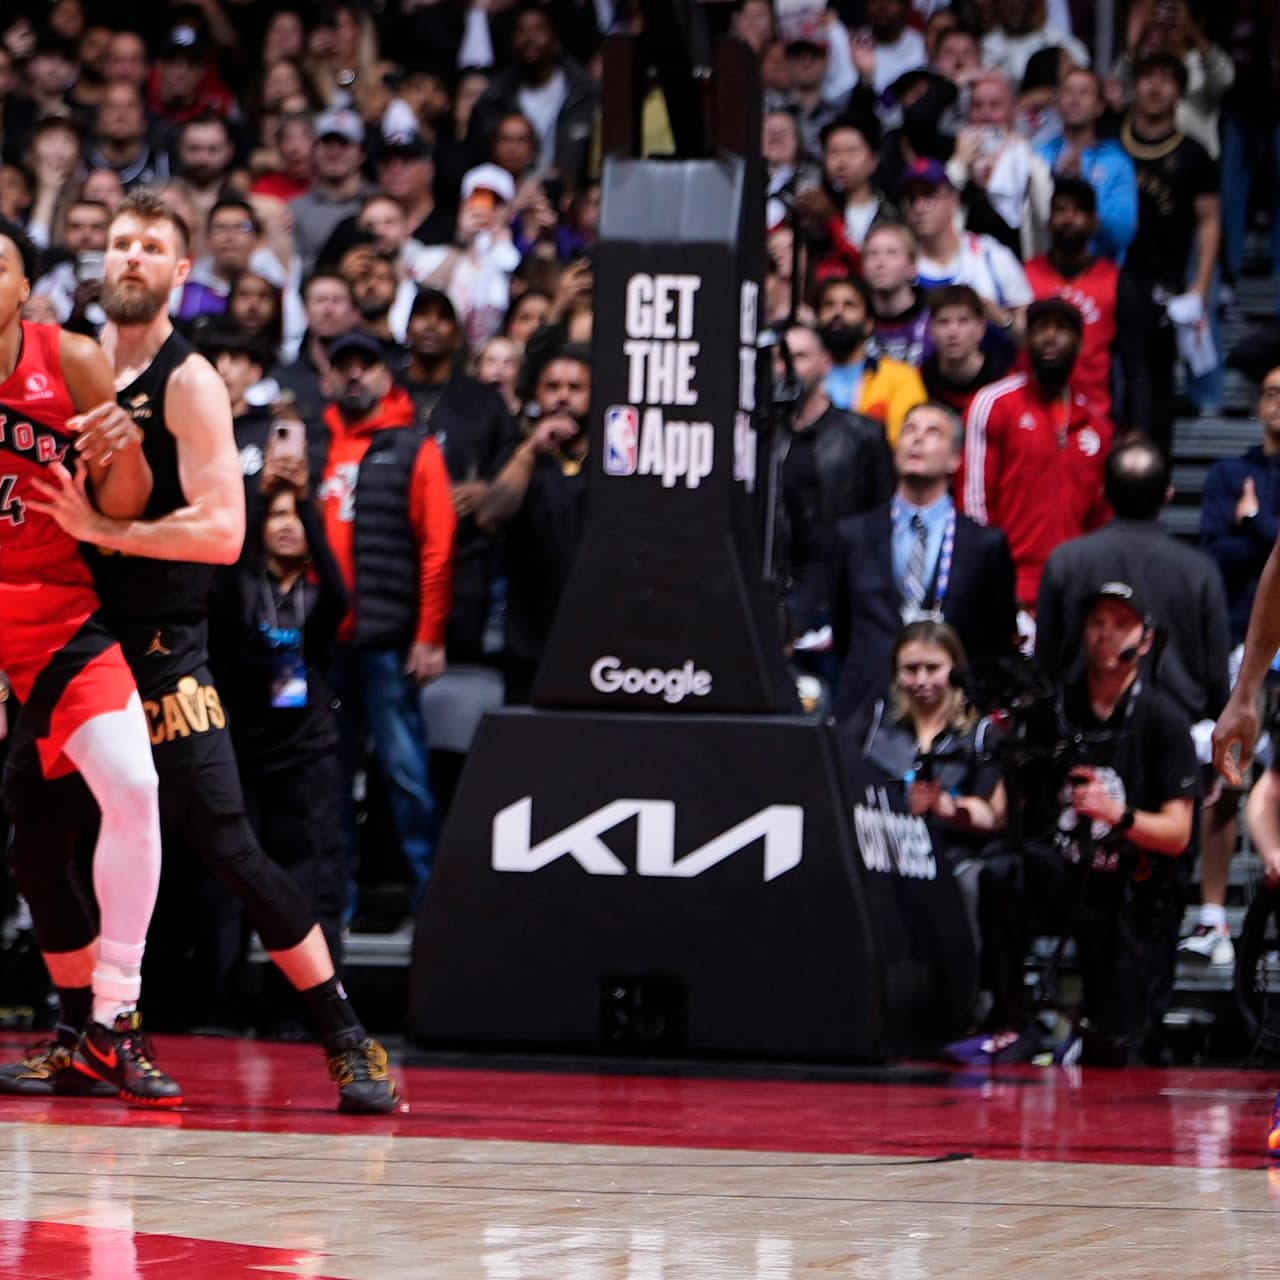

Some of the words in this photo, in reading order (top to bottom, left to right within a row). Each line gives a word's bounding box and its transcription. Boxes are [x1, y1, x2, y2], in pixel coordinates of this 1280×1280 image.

[625, 272, 702, 339] GET
[623, 340, 700, 406] THE
[637, 407, 715, 489] App
[143, 676, 226, 746] CAVS
[589, 656, 713, 704] Google
[492, 794, 804, 883] KIA
